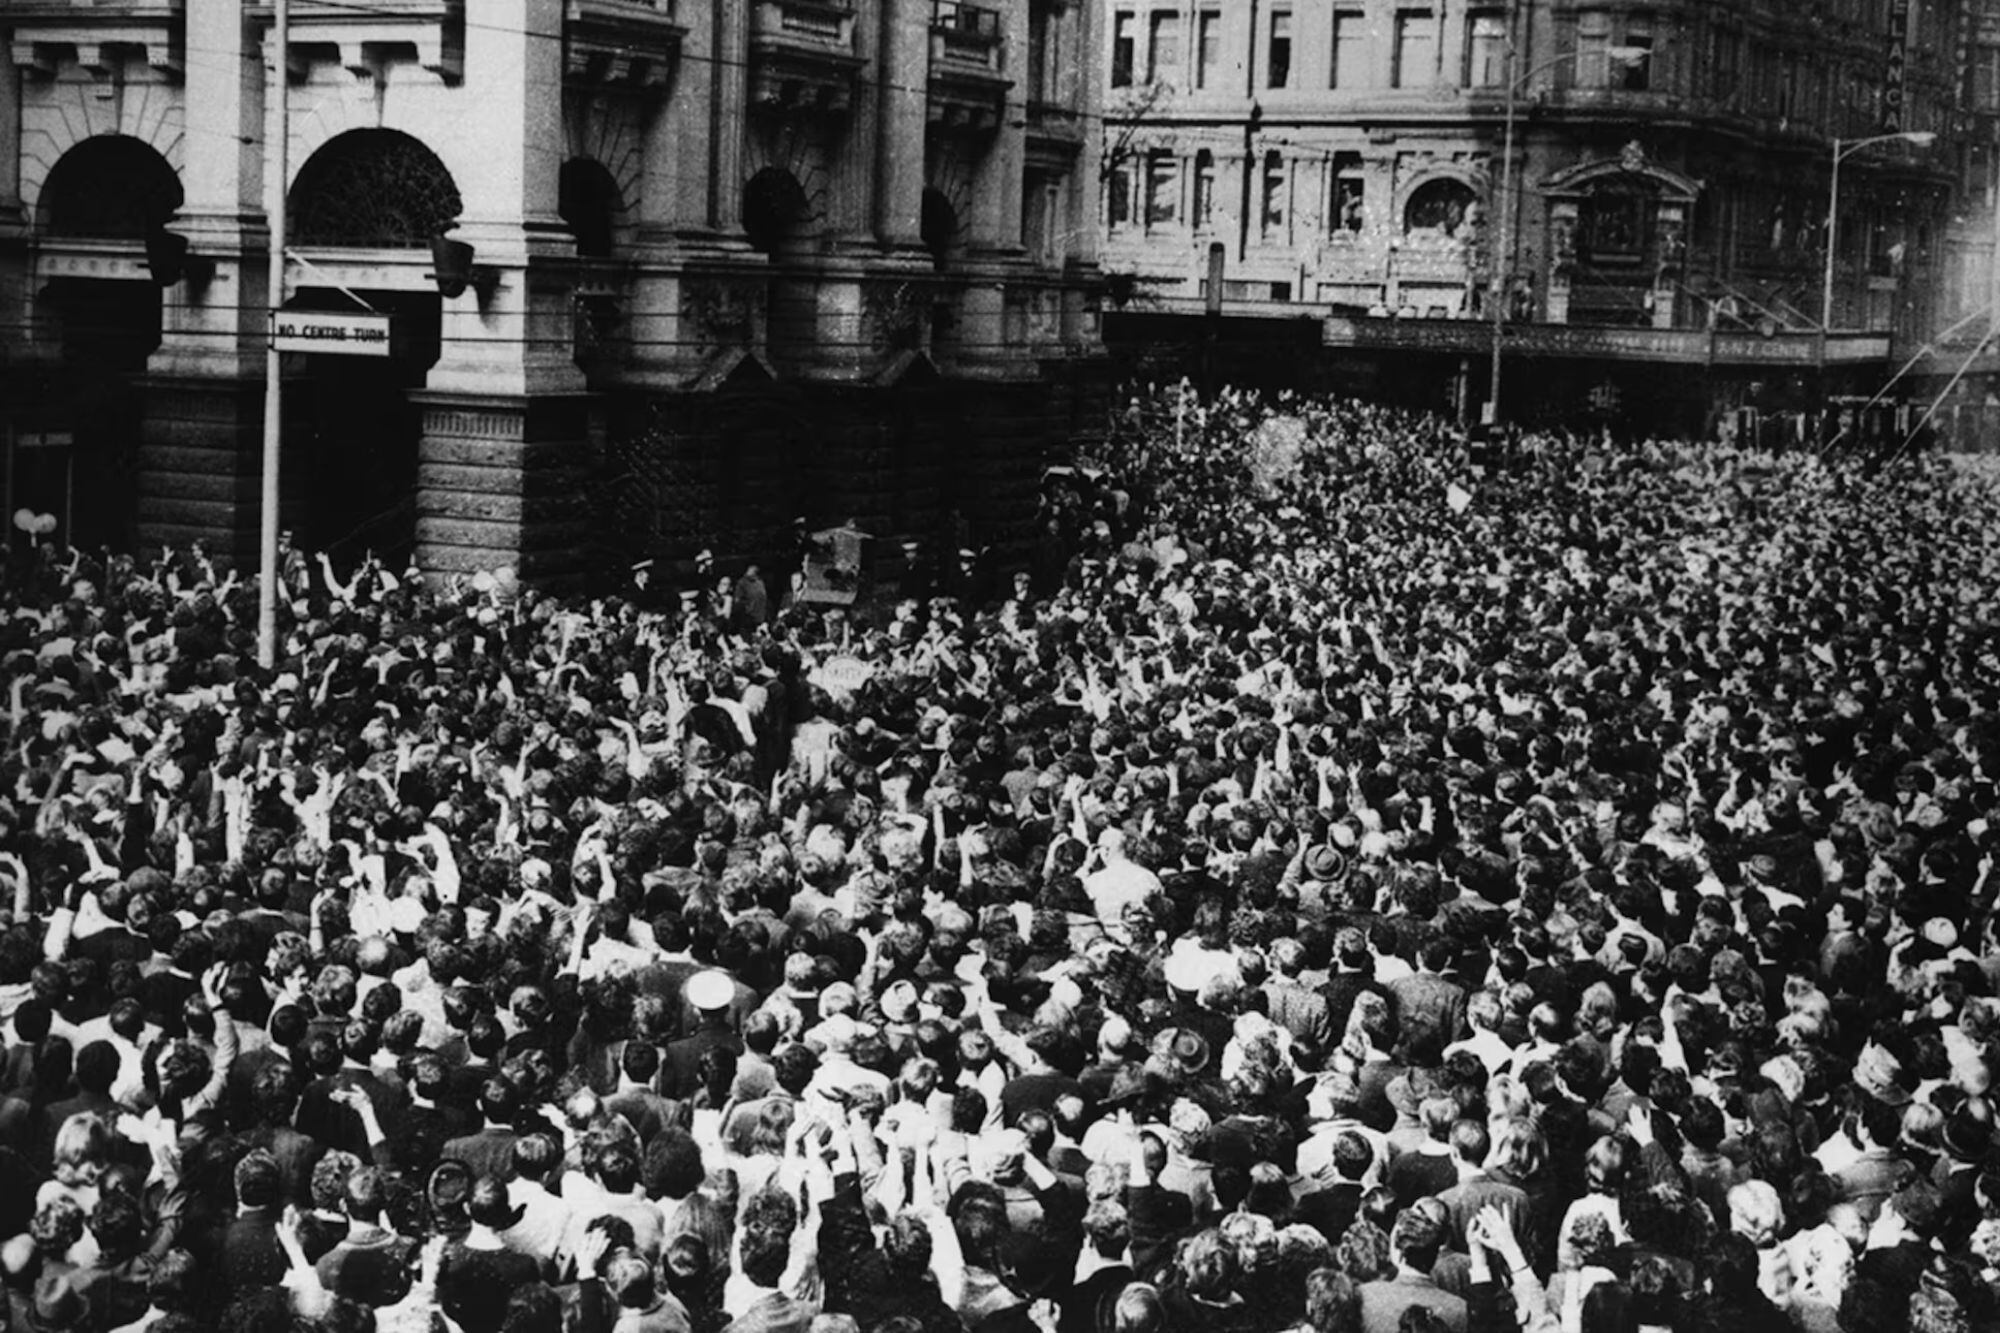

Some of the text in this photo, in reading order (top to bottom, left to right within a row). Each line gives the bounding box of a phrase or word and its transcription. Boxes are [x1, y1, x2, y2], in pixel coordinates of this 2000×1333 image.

[278, 324, 386, 343] NO CENTRE TURN
